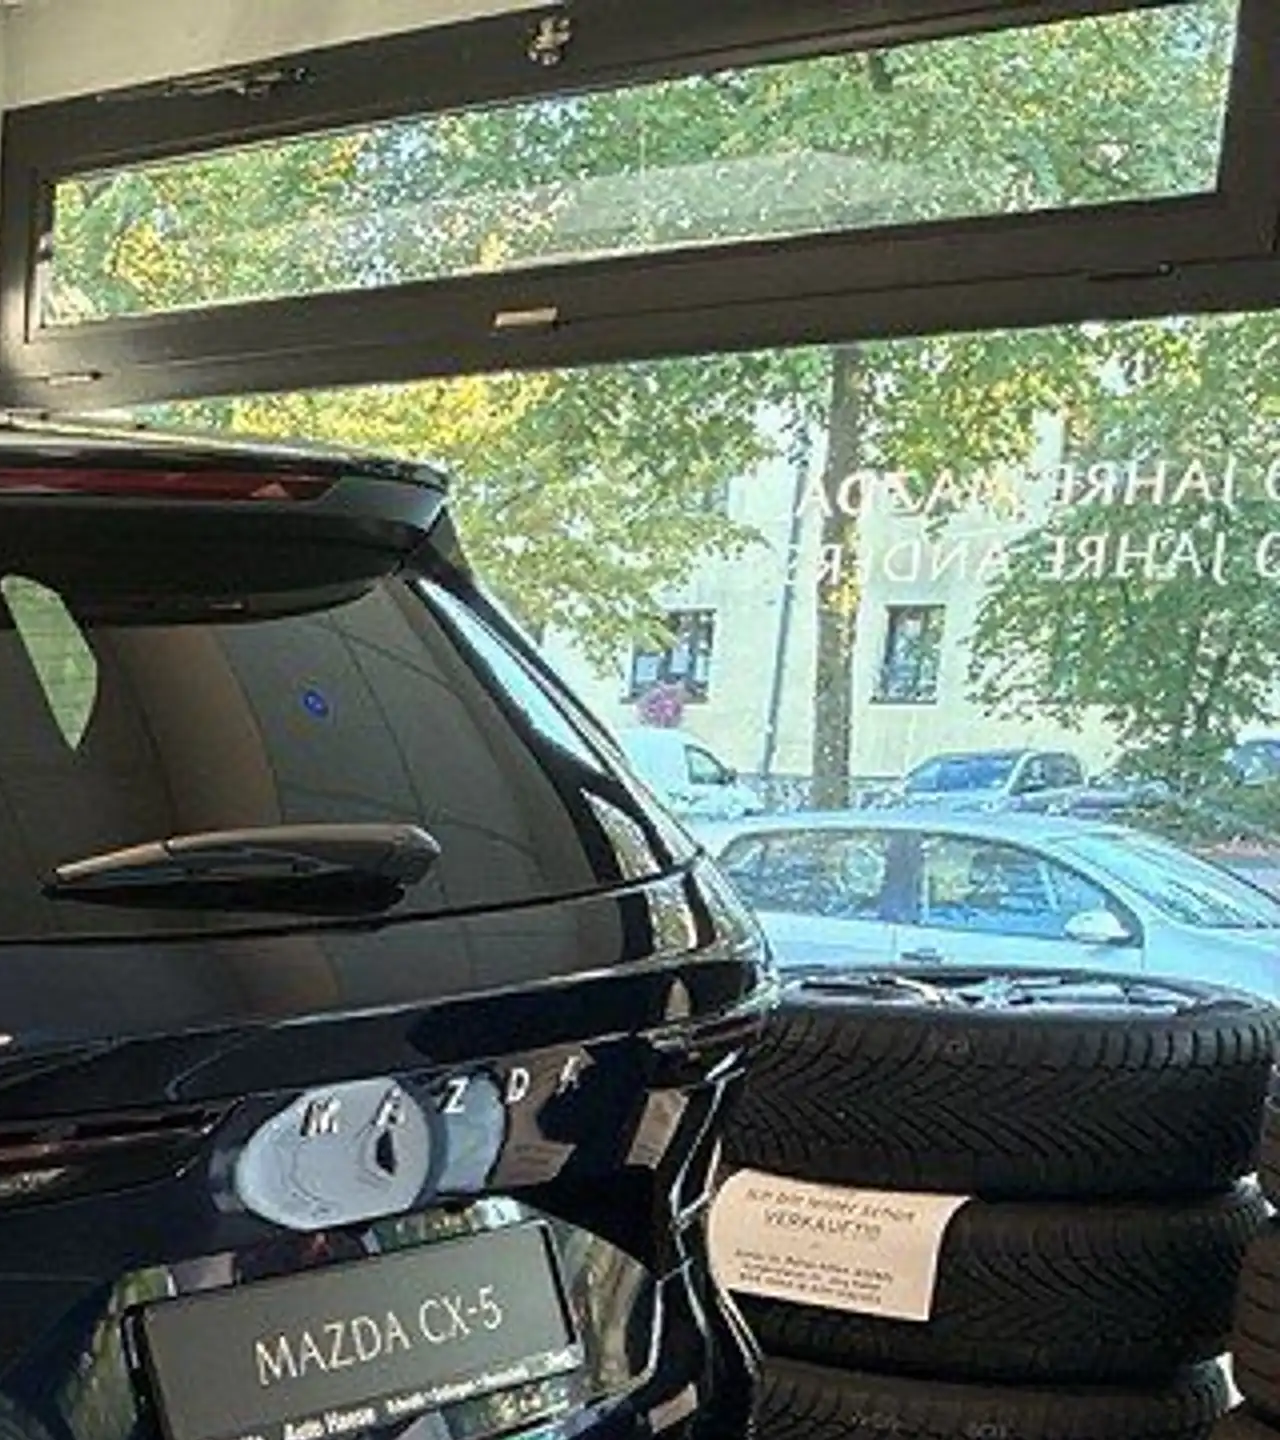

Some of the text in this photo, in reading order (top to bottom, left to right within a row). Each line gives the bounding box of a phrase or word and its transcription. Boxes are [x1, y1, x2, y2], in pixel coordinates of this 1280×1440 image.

[300, 1052, 586, 1138] MAZDA
[254, 1284, 504, 1386] MAZDA CX-5
